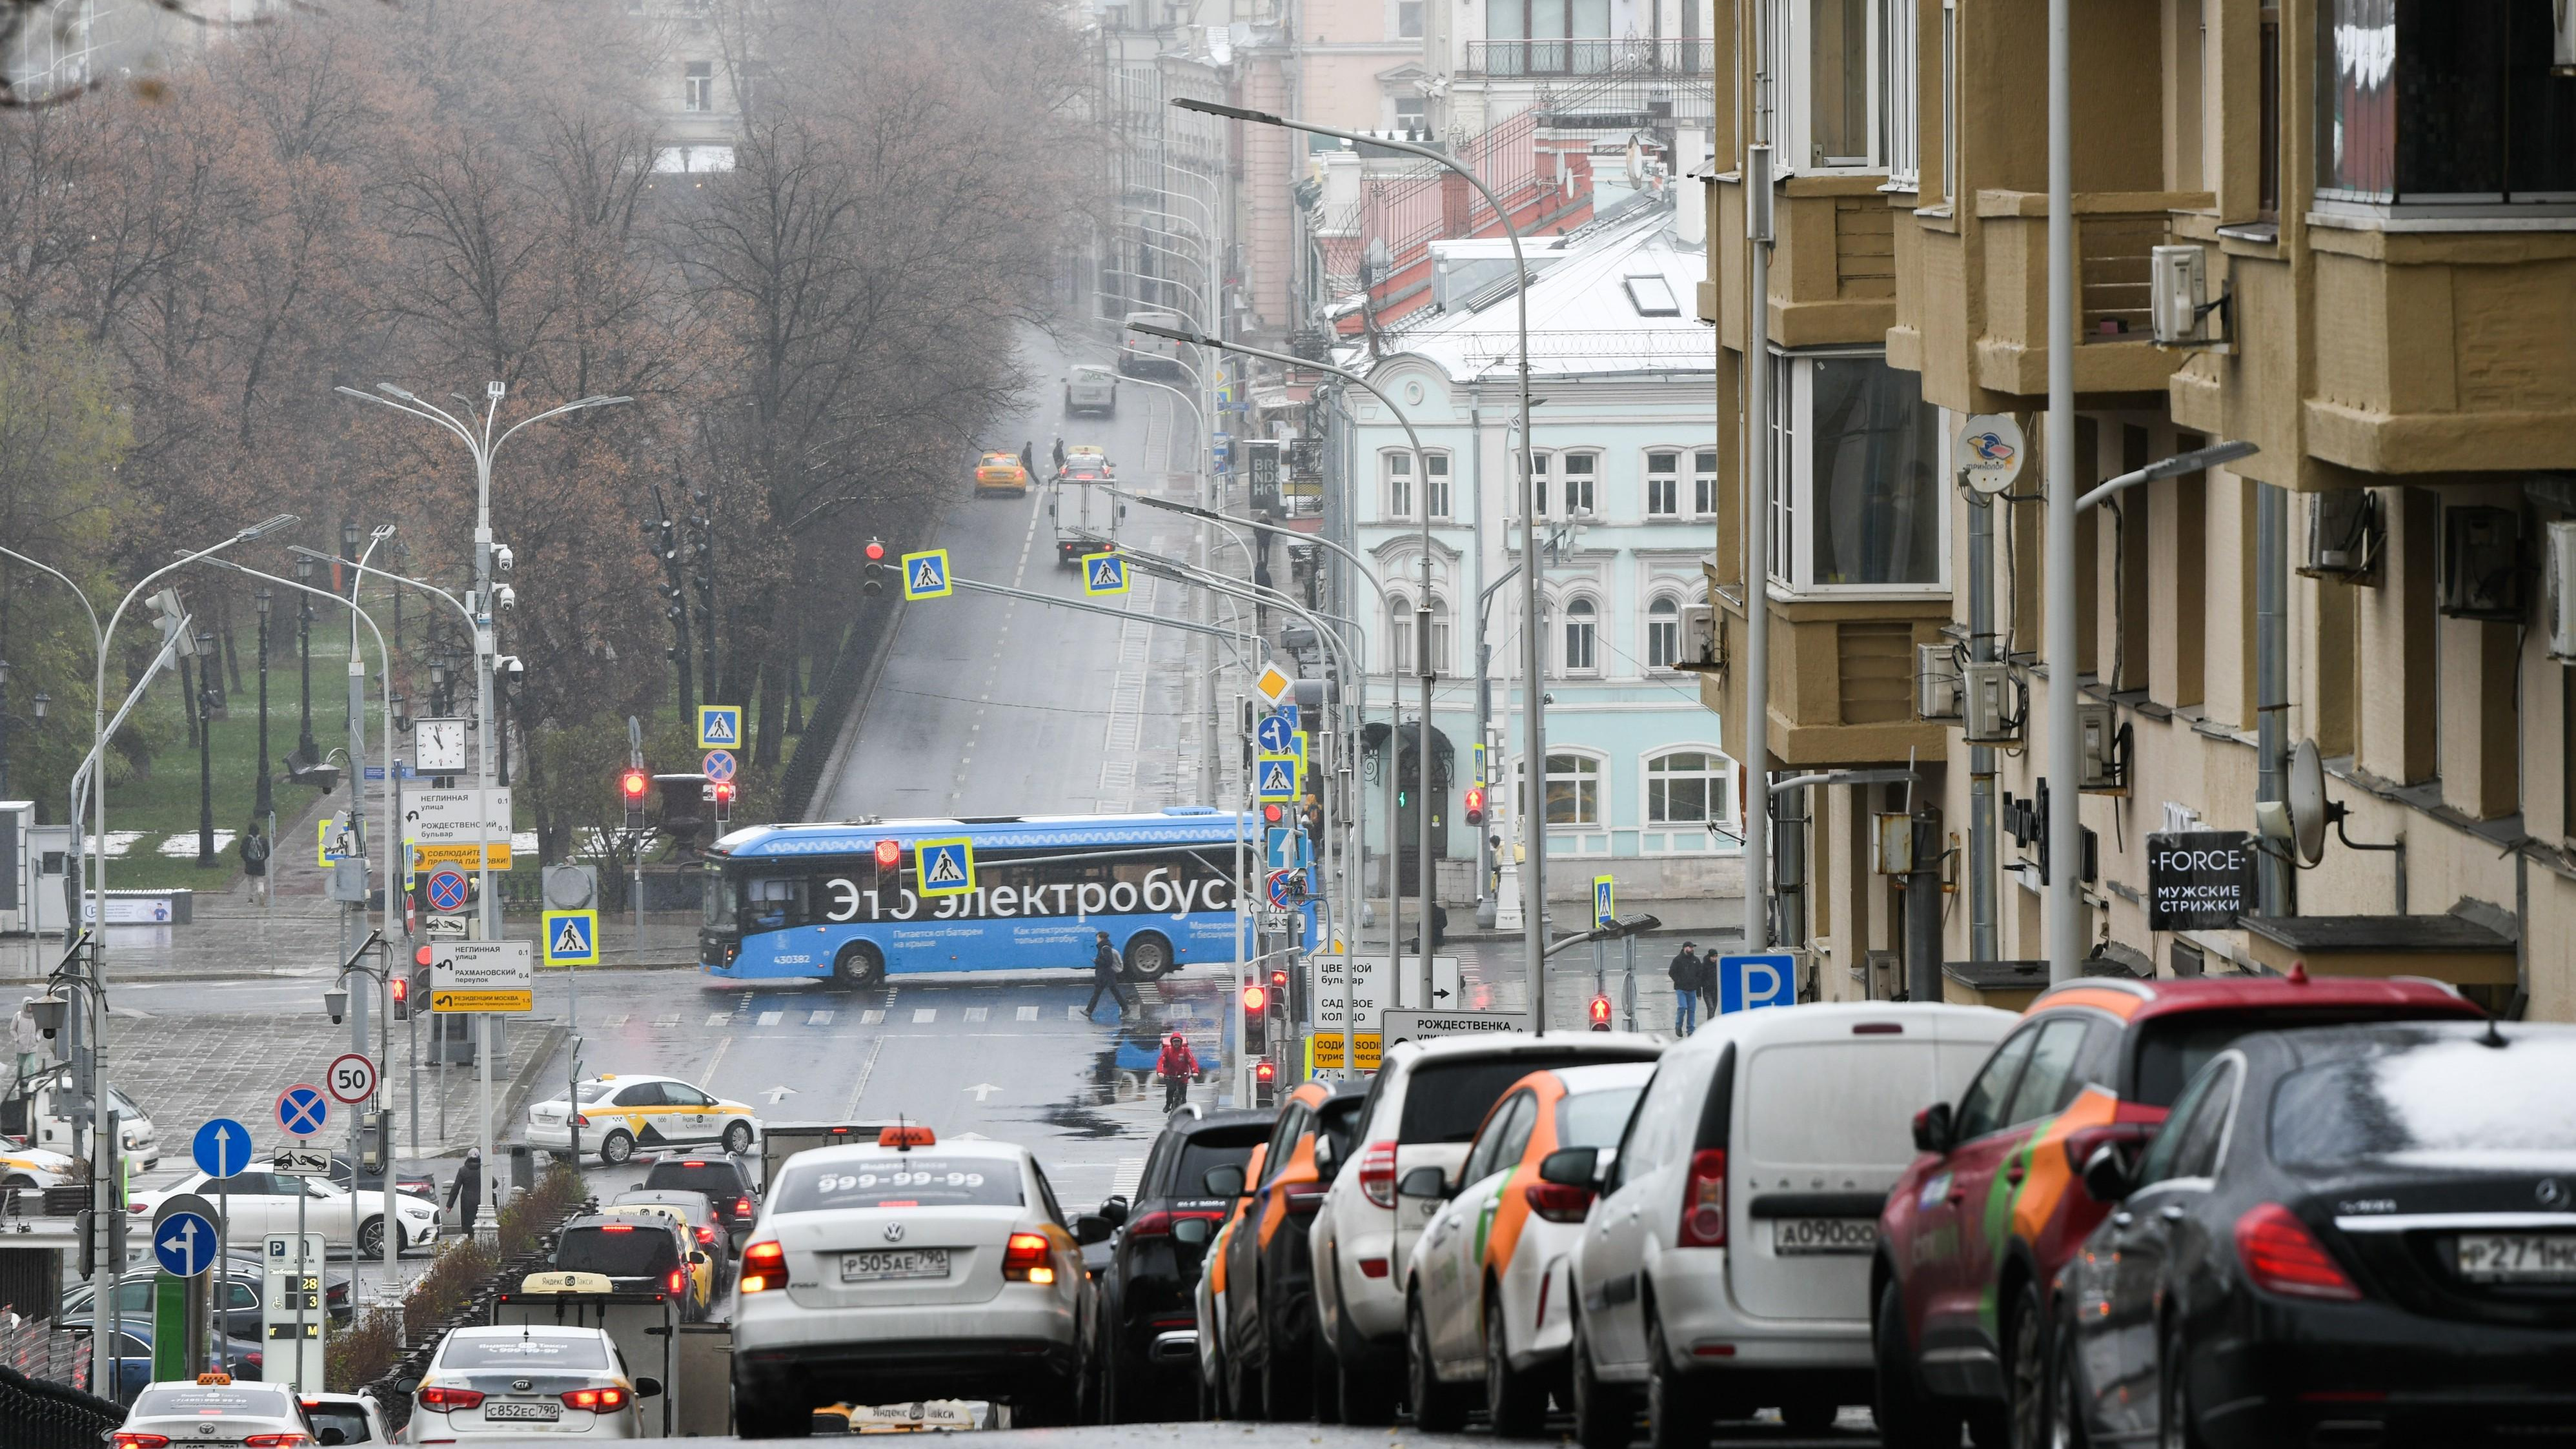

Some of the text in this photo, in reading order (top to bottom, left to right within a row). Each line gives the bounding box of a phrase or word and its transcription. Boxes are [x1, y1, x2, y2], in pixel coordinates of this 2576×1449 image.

[421, 821, 496, 830] РОЖДЕСТВЕНСИЙ
[2158, 885, 2241, 899] МУЖСКИЕ
[2160, 900, 2240, 913] СТРИЖКИ
[774, 955, 810, 964] 430382
[1321, 963, 1372, 974] ЦВЕНОЙ
[1321, 975, 1364, 986] бульар
[1321, 998, 1374, 1009] САДВОЕ
[1321, 1013, 1366, 1022] КОЛЦО
[1417, 1019, 1512, 1031] РОЖДЕСТВЕНКА
[1317, 1040, 1381, 1051] СОДИ SODI
[338, 1069, 366, 1089] 50
[818, 1171, 984, 1193] 999-99-99
[303, 1278, 317, 1290] 28
[542, 1276, 593, 1286] Яндекс Go Такси
[309, 1295, 317, 1307] 3
[491, 1405, 555, 1417] С852ЕС 790
